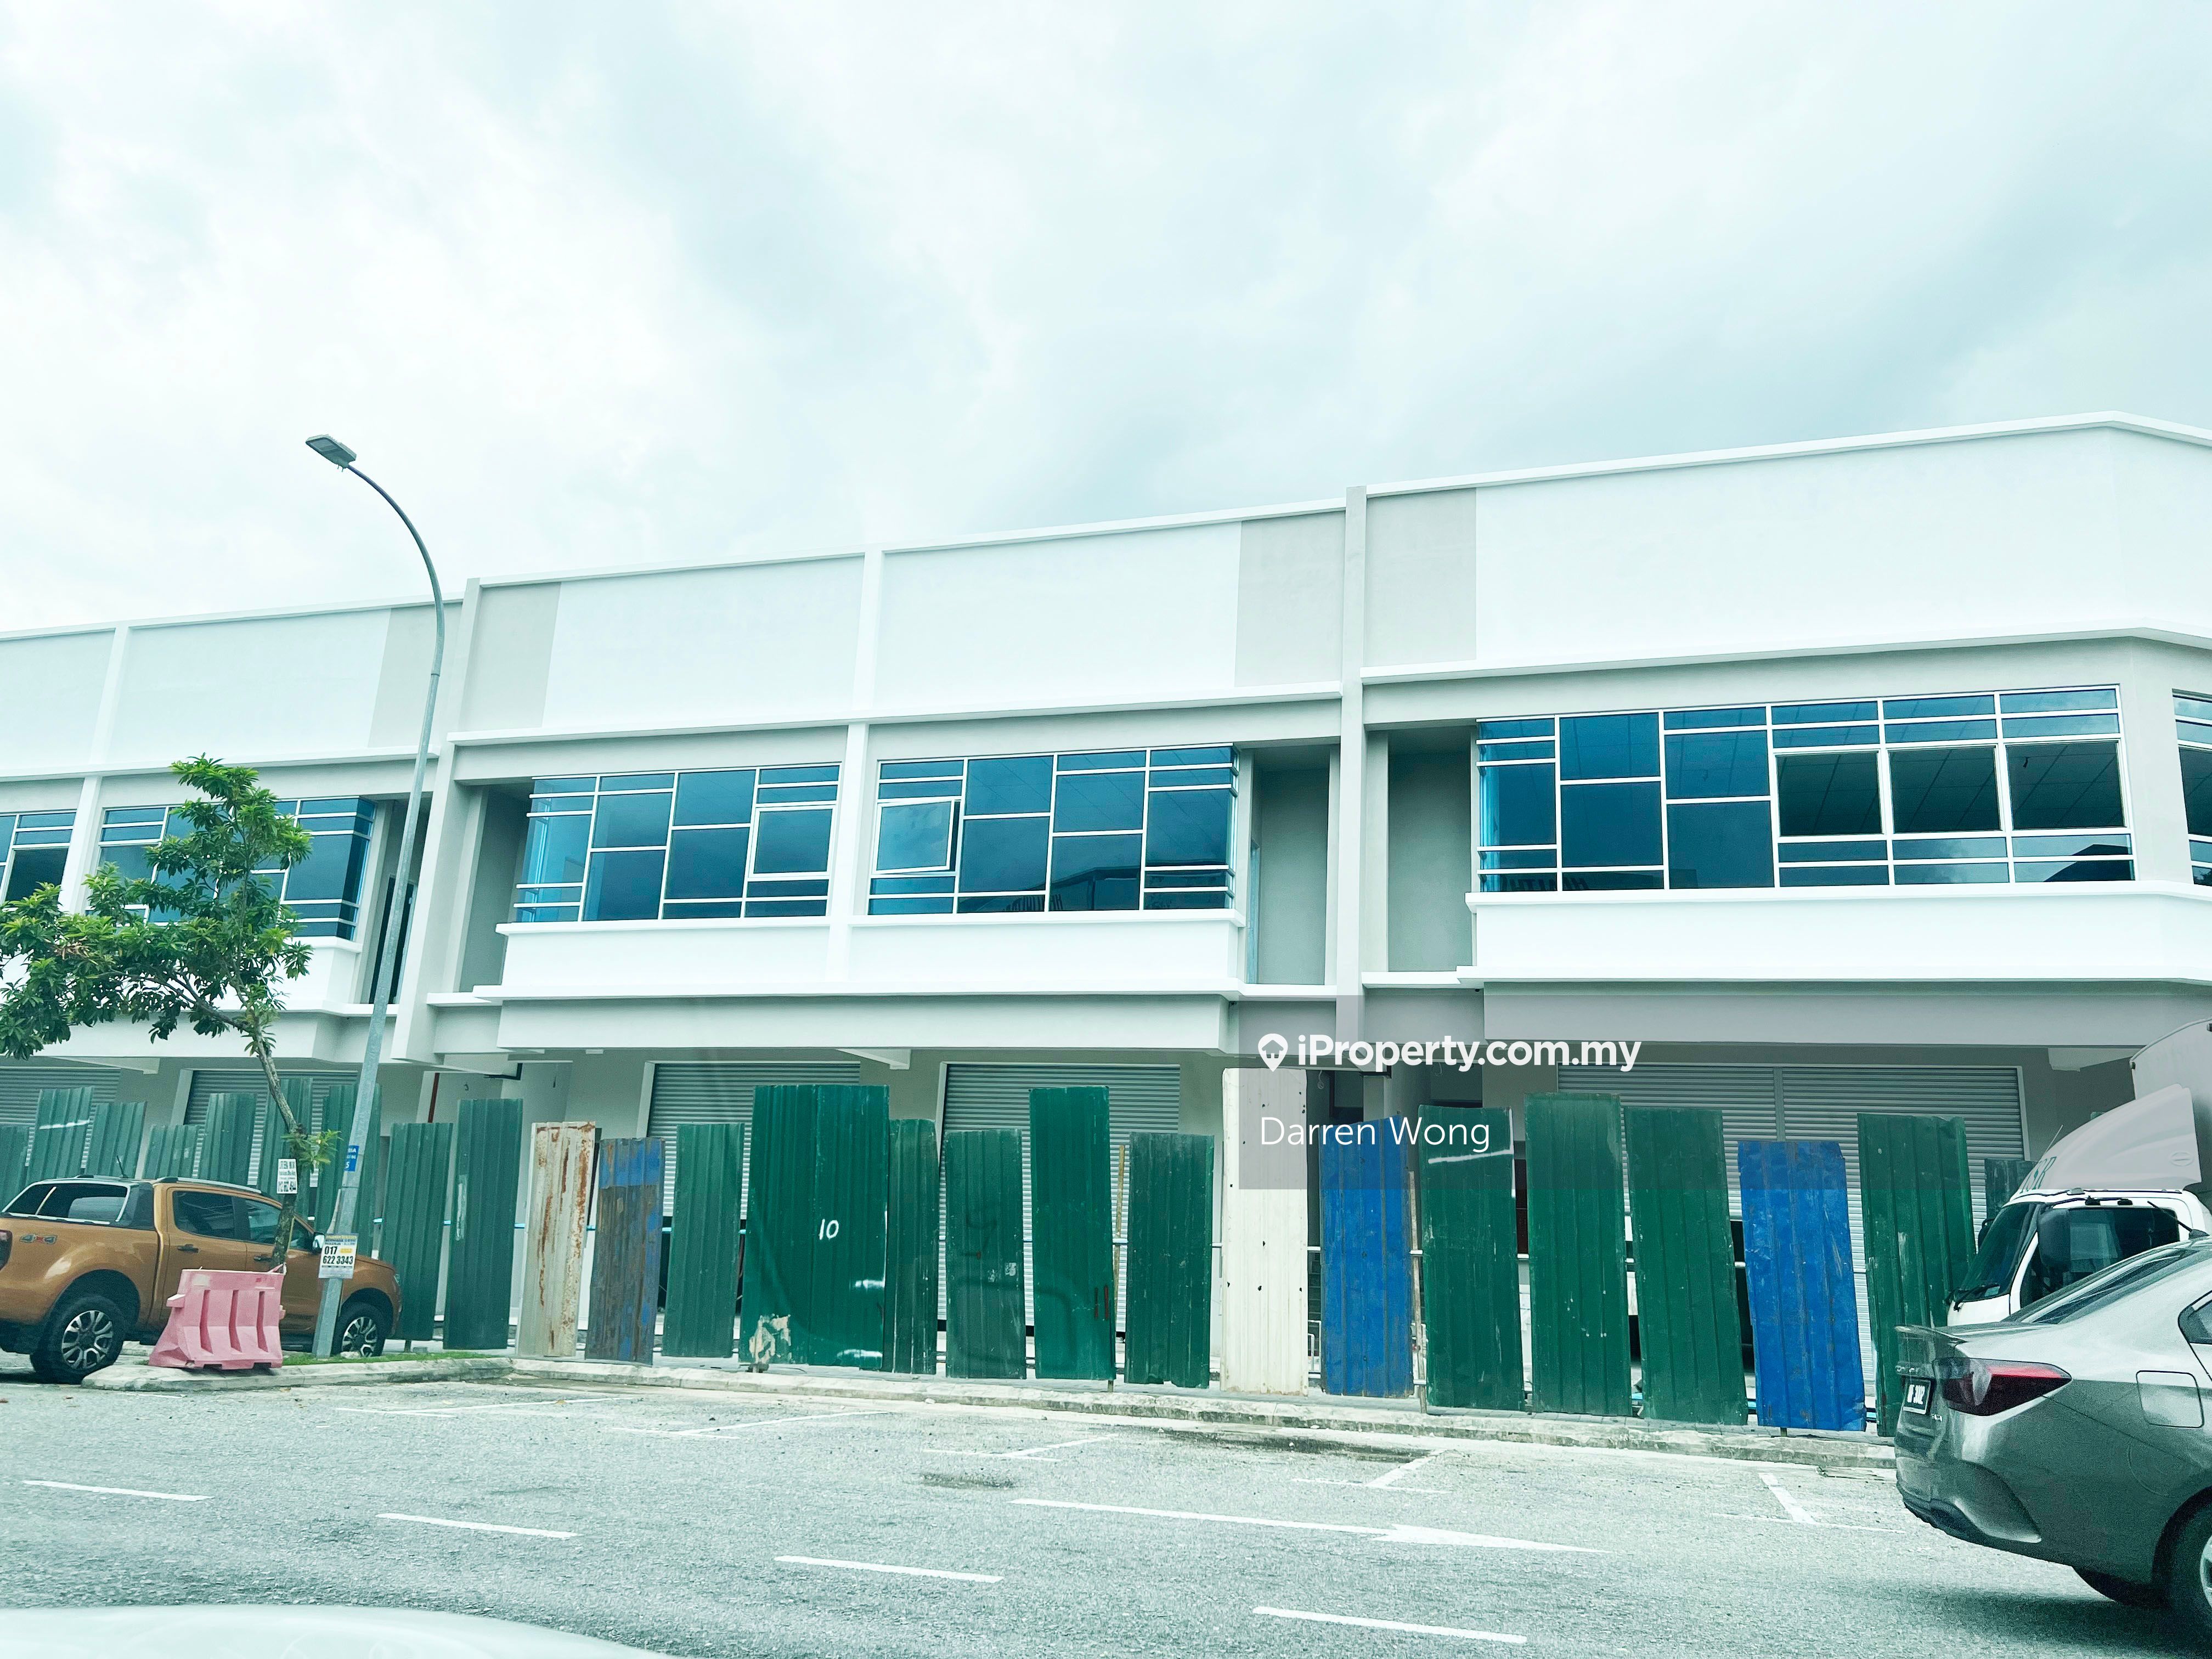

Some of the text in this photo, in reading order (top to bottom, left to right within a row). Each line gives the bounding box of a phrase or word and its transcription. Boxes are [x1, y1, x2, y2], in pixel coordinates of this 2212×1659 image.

[819, 1218, 839, 1240] 10
[324, 1246, 338, 1255] 017
[321, 1256, 353, 1265] 622 3343
